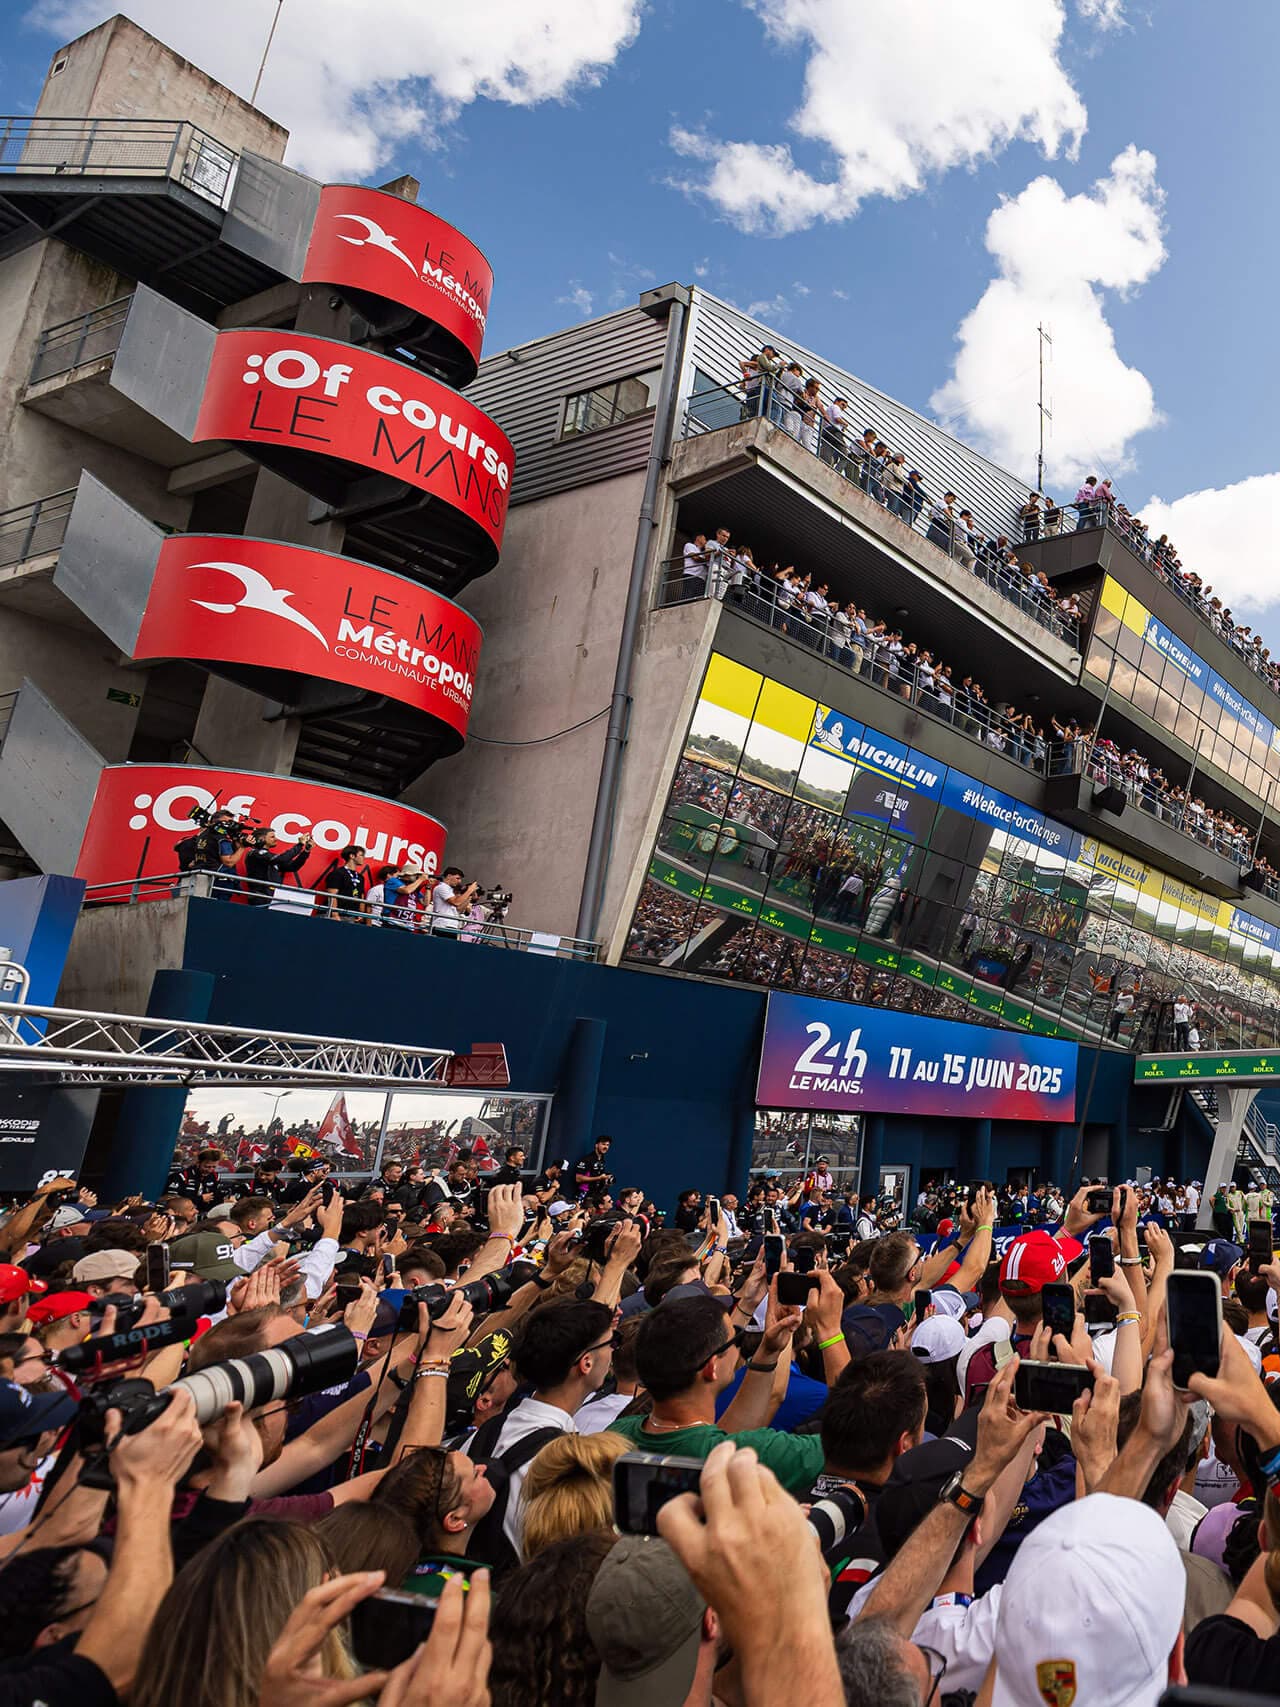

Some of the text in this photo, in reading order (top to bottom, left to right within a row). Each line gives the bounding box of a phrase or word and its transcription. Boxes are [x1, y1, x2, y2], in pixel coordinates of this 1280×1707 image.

[425, 241, 455, 275] LE
[249, 390, 502, 529] LE MANS
[366, 385, 509, 490] course
[343, 587, 478, 676] LE MANS
[1159, 635, 1202, 678] MICHELIN
[334, 645, 438, 690] COMMUNAUTÉ
[337, 618, 473, 700] Métropole
[846, 737, 938, 788] MICHELIN
[270, 813, 438, 874] course
[962, 788, 1062, 845] #WeRaceForChange
[1097, 853, 1149, 884] MICHELIN
[1239, 920, 1271, 941] MICHELIN
[789, 1075, 812, 1090] LE
[793, 1021, 1063, 1094] 24h 11 AU 15 JUIN 2025
